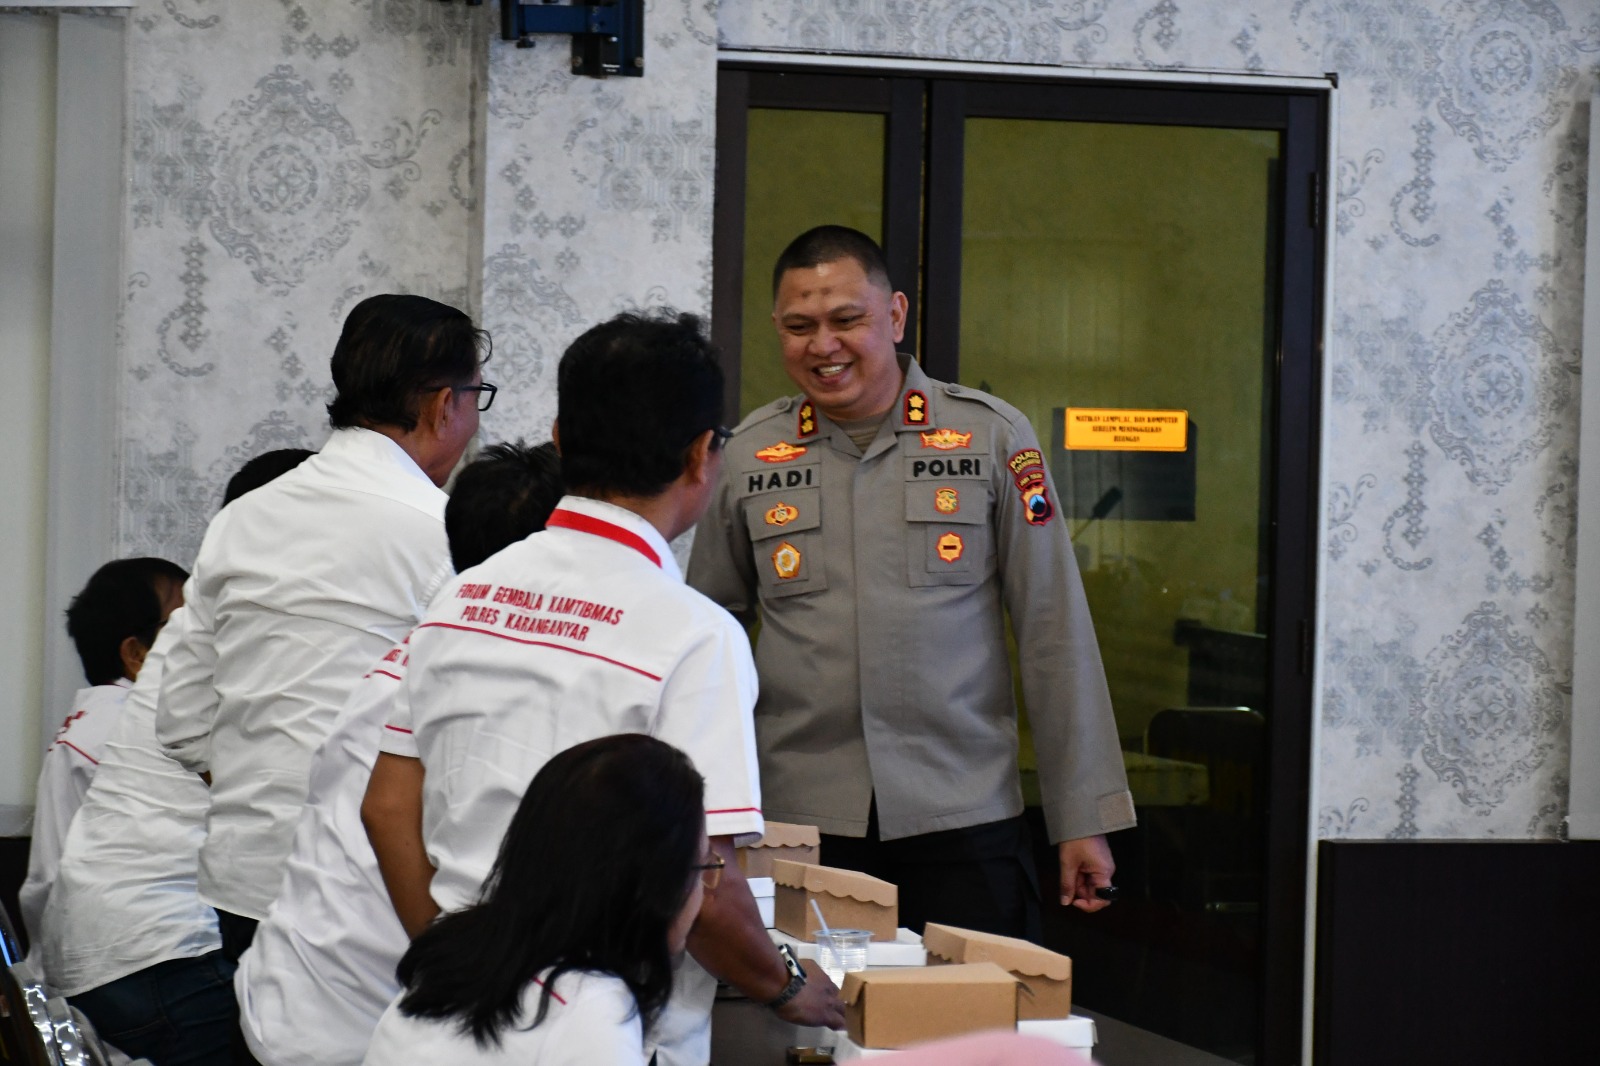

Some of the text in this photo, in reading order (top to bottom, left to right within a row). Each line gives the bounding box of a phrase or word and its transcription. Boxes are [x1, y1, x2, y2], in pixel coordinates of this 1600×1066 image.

[913, 458, 981, 478] POLRI
[1009, 450, 1040, 469] POLRES
[748, 468, 812, 493] HADI
[456, 583, 624, 626] FORUM GEMBALA KAMTIBMAS
[461, 605, 590, 642] POLRES KARANGANYAR
